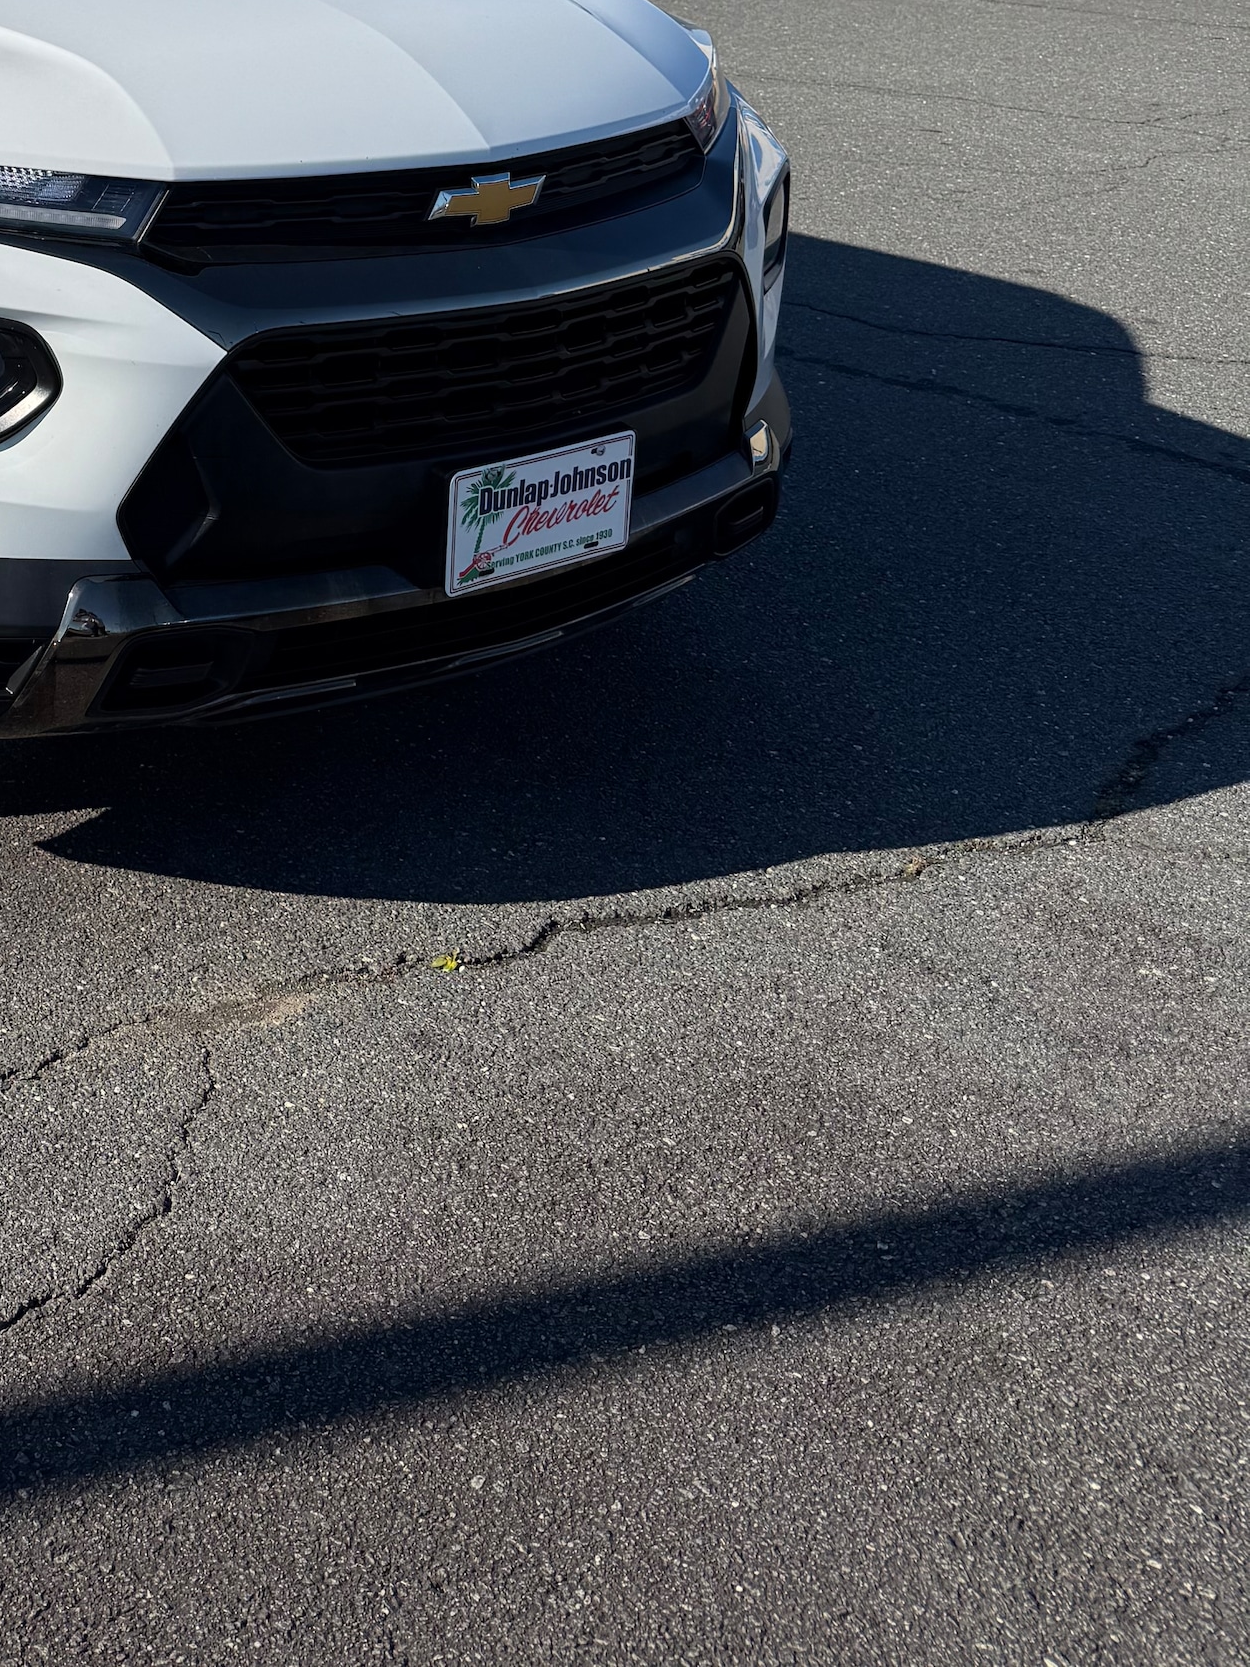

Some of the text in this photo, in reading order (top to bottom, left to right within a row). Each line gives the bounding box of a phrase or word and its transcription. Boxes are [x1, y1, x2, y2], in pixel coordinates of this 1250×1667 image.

[503, 485, 620, 546] Chevrolet
[516, 550, 534, 563] YORK
[535, 542, 564, 557] COUNTY
[563, 539, 575, 550] S.C.
[596, 528, 613, 540] 1930
